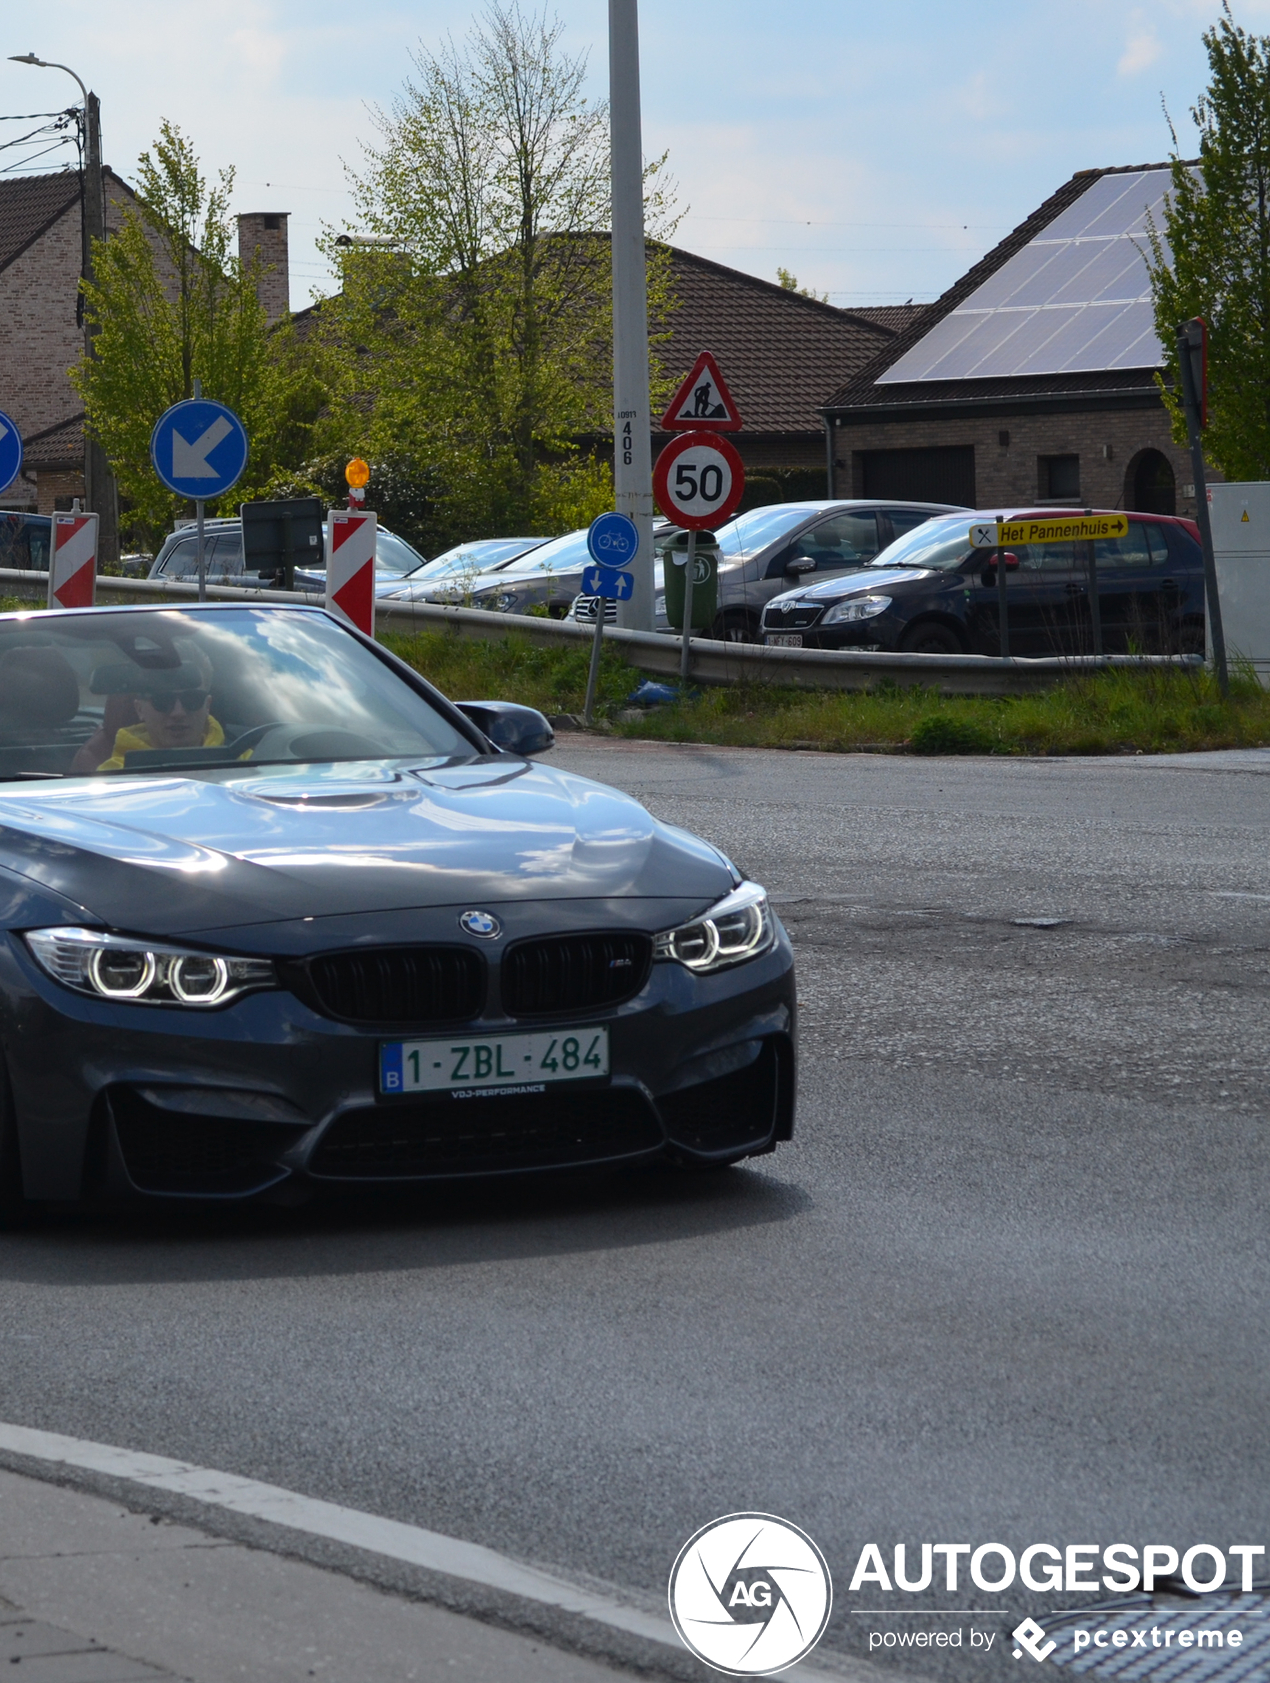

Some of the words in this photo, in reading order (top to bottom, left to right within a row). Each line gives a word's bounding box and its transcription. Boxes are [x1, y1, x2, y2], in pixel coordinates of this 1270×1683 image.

[622, 421, 632, 466] 406
[675, 464, 723, 501] 50
[1000, 526, 1024, 542] Het
[1029, 520, 1109, 540] Pannenhuis
[386, 1071, 400, 1088] B
[407, 1035, 602, 1083] 1-ZBL-484
[451, 1084, 546, 1099] VDJ-PERFORMANCE
